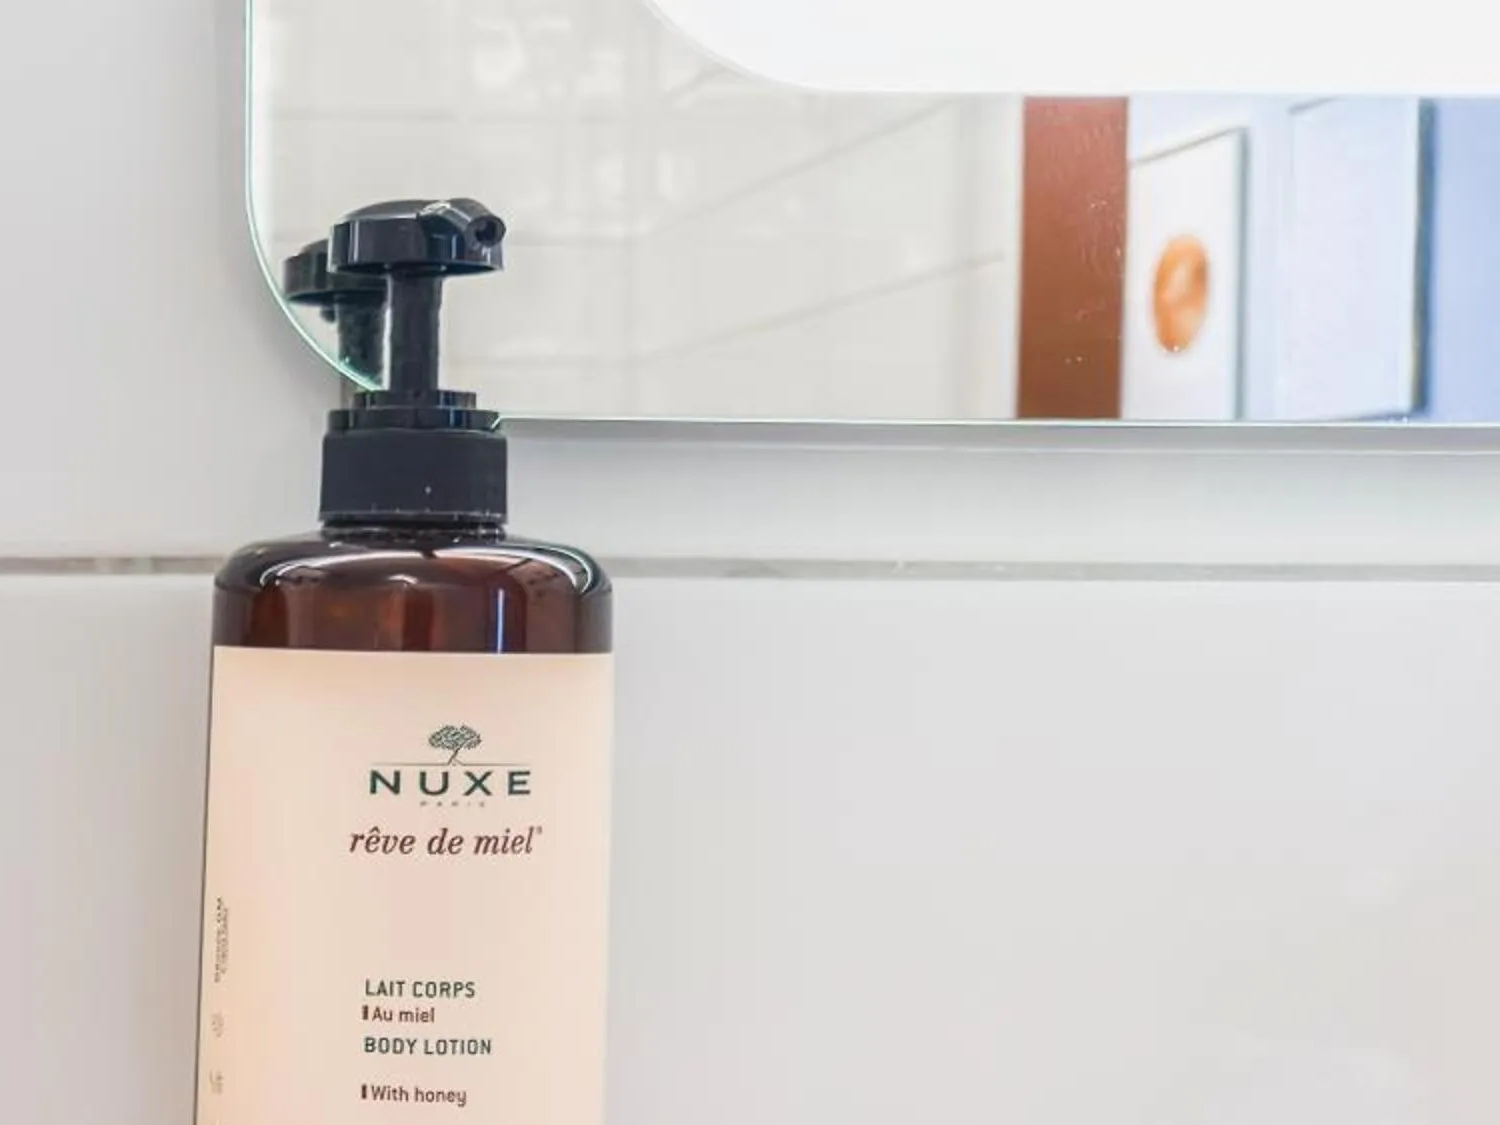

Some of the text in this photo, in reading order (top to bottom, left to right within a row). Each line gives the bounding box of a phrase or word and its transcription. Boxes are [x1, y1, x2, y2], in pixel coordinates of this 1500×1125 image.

[369, 770, 532, 796] NUXE
[349, 826, 416, 854] rêve
[427, 828, 464, 855] de
[365, 979, 476, 998] LAIT CORPS
[372, 1006, 435, 1023] Au miel
[364, 1037, 492, 1055] BODY LOTION
[371, 1085, 467, 1107] With honey
